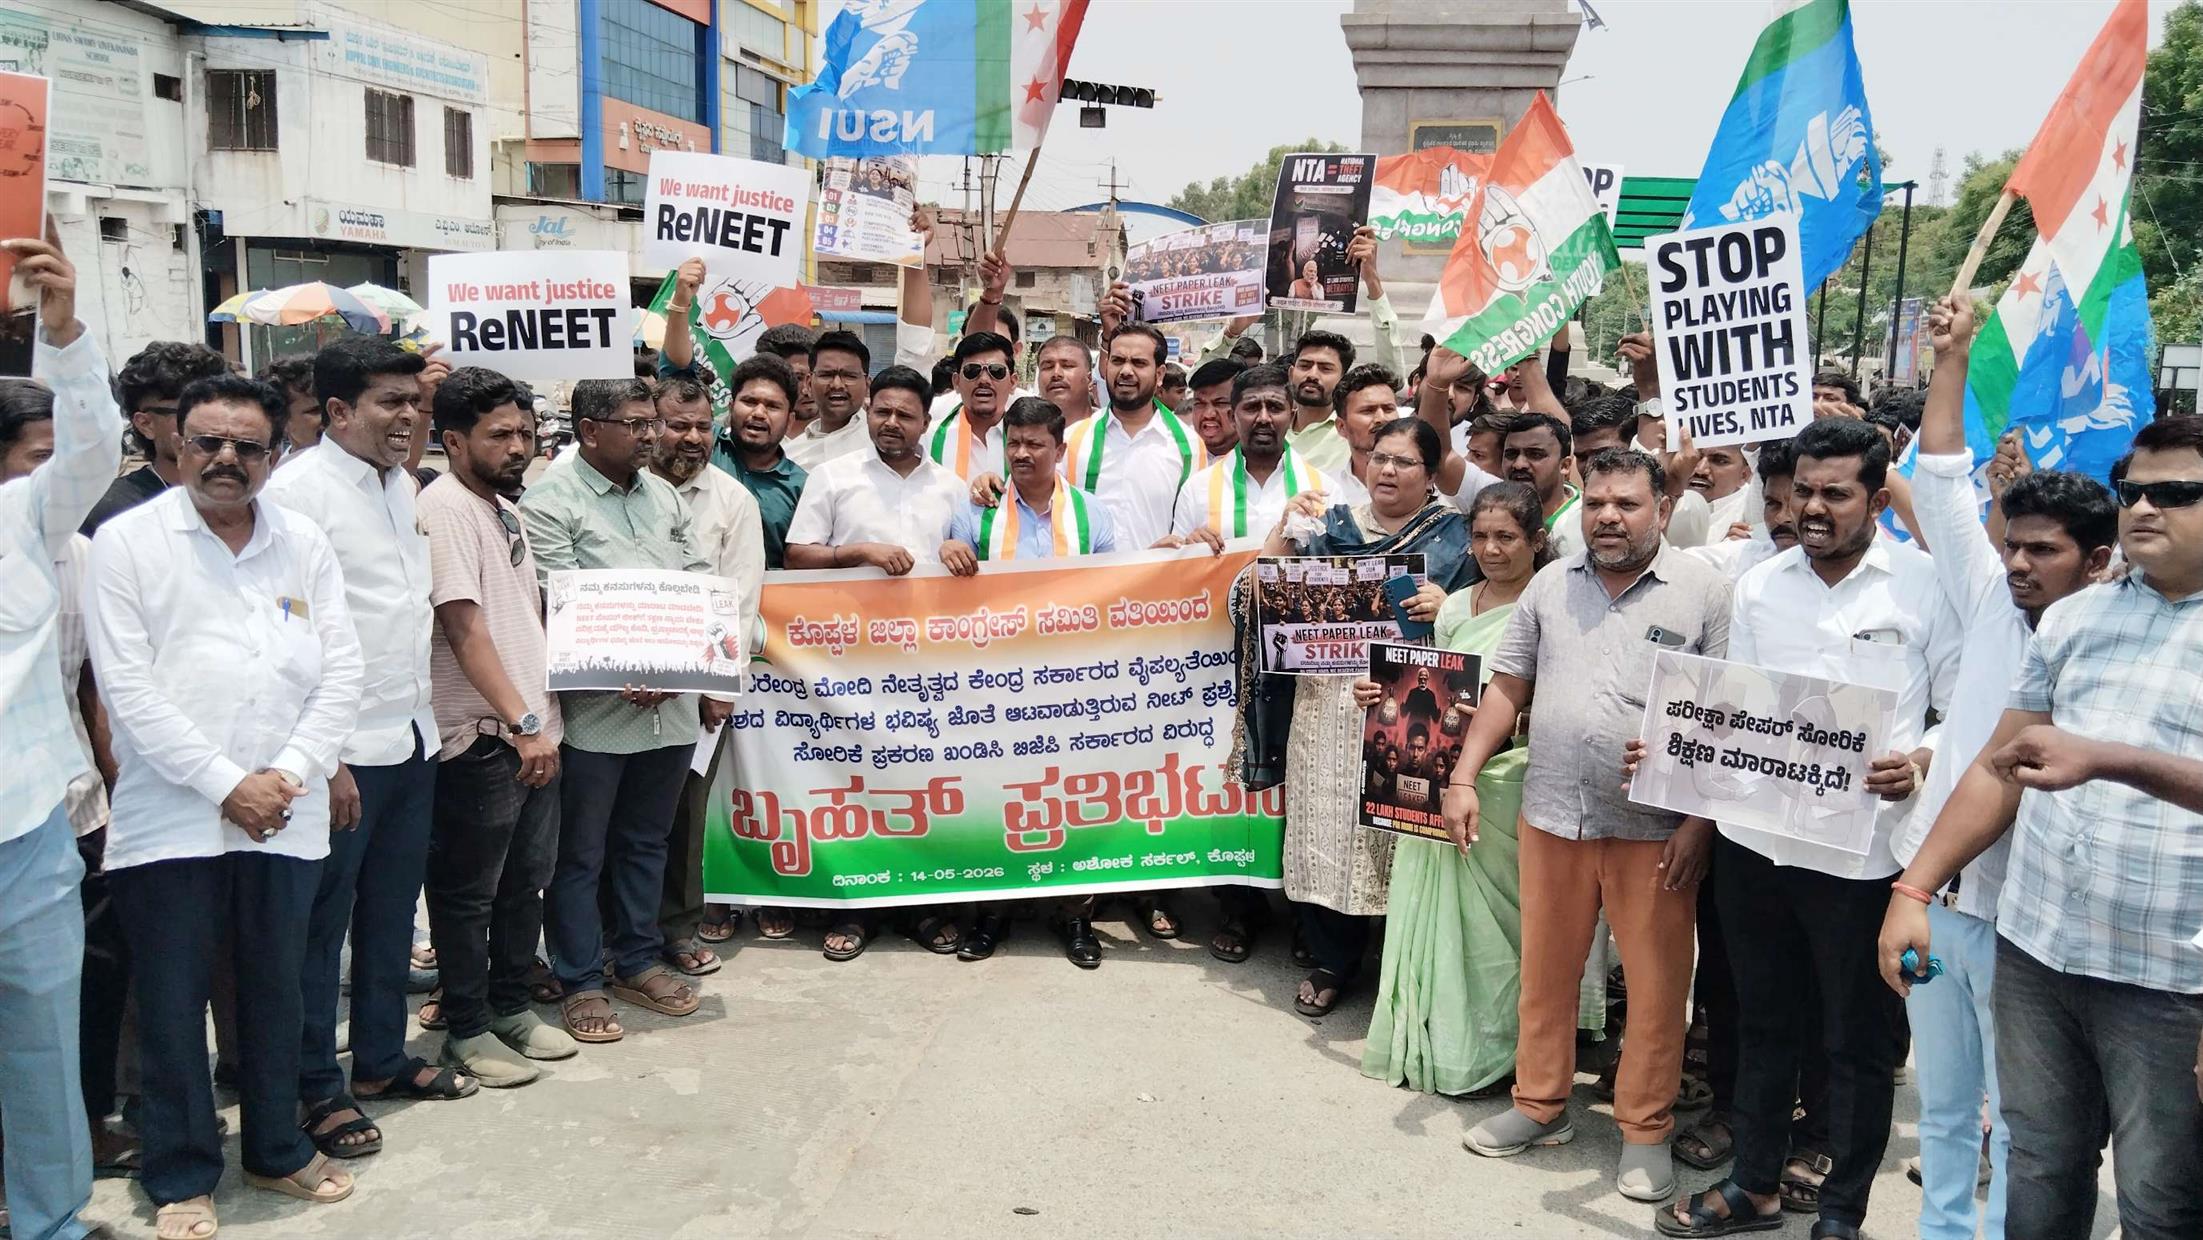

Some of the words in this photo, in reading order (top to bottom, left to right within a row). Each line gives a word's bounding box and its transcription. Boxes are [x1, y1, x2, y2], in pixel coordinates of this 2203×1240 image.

[1291, 159, 1325, 183] NTA
[1337, 174, 1362, 183] AGENCY
[1339, 164, 1363, 174] THEFT
[659, 178, 682, 197] We
[685, 183, 730, 201] want
[731, 184, 794, 213] justice
[828, 191, 839, 201] 01
[338, 208, 385, 229] ಯಮಹಾ
[657, 203, 791, 257] ReNEET
[340, 227, 387, 241] YAMAHA
[1657, 227, 1786, 293] STOP
[448, 283, 479, 302] We
[484, 280, 540, 301] want
[545, 278, 616, 305] justice
[1152, 283, 1174, 295] NEET
[1177, 279, 1206, 292] PAPER
[1208, 276, 1232, 288] LEAK
[1162, 290, 1224, 311] STRIKE
[1664, 282, 1792, 330] PLAYING
[450, 308, 616, 352] ReNEET
[1668, 319, 1795, 382] WITH
[1674, 371, 1799, 412] STUDENTS
[1750, 403, 1795, 430] NTA
[714, 601, 734, 609] LEAK
[788, 615, 858, 656] ಕೊಪ್ಪಳ
[870, 617, 918, 651] ಜಿಲ್ಲಾ
[1038, 604, 1098, 637] ಸಮಿತಿ
[1110, 590, 1211, 630] ವತಿಯಿಂದ
[1295, 627, 1320, 642] NEET
[1322, 626, 1355, 640] PAPER
[1359, 625, 1388, 639] LEAK
[1305, 642, 1369, 660] STRIK
[1386, 647, 1408, 665] NEET
[1409, 649, 1439, 668] PAPER
[1440, 653, 1464, 672] LEAK
[814, 677, 872, 698] ಮೋದಿ
[882, 671, 958, 702] ನೇತೃತ್ವದ
[969, 668, 1024, 692] ಕೇಂದ್ರ
[1034, 660, 1119, 686] ಸರ್ಕಾರದ
[775, 709, 875, 740] ವಿದ್ಯಾರ್ಥಿಗಳ
[885, 707, 940, 738] ಭವಿಷ್ಯ
[948, 703, 996, 727] ಜೊತೆ
[1005, 694, 1137, 723] ಆಟವಾಡುತ್ತಿರುವ
[1146, 687, 1193, 710] ನೀಟ್
[1666, 699, 1726, 732] ಪರೀಕ್ಷಾ
[1729, 710, 1794, 738] ಪೇಪರ್
[1797, 721, 1867, 753] ಸೋರಿಕೆ
[793, 741, 862, 763] ಸೋರಿಕೆ
[871, 745, 934, 769] ಪ್ರಕರಣ
[944, 739, 1004, 761] ಖಂಡಿಸಿ
[1013, 735, 1060, 757] ಬಿಜೆಪಿ
[1070, 724, 1153, 751] ಸರ್ಕಾರದ
[1163, 717, 1214, 749] ವಿರುದ್ಧ
[1667, 731, 1715, 769] ಶಿಕ್ಷಣ
[1720, 746, 1851, 797] ಮಾರಾಟಕ್ಕಿದೆ!
[1403, 779, 1422, 792] NEET
[731, 775, 965, 877] ಬೃಹತ್
[1366, 801, 1376, 815] 22
[1376, 804, 1394, 817] LAKH
[1394, 808, 1428, 825] STUDENTS
[833, 869, 890, 886] ದಿನಾಂಕ
[910, 867, 1005, 882] 14-05-2026
[1027, 862, 1053, 883] ಸ್ಥಳ
[1072, 854, 1134, 872] ಅಶೋಕ
[1207, 848, 1255, 869] ಕೊಪ್ಪಳ
